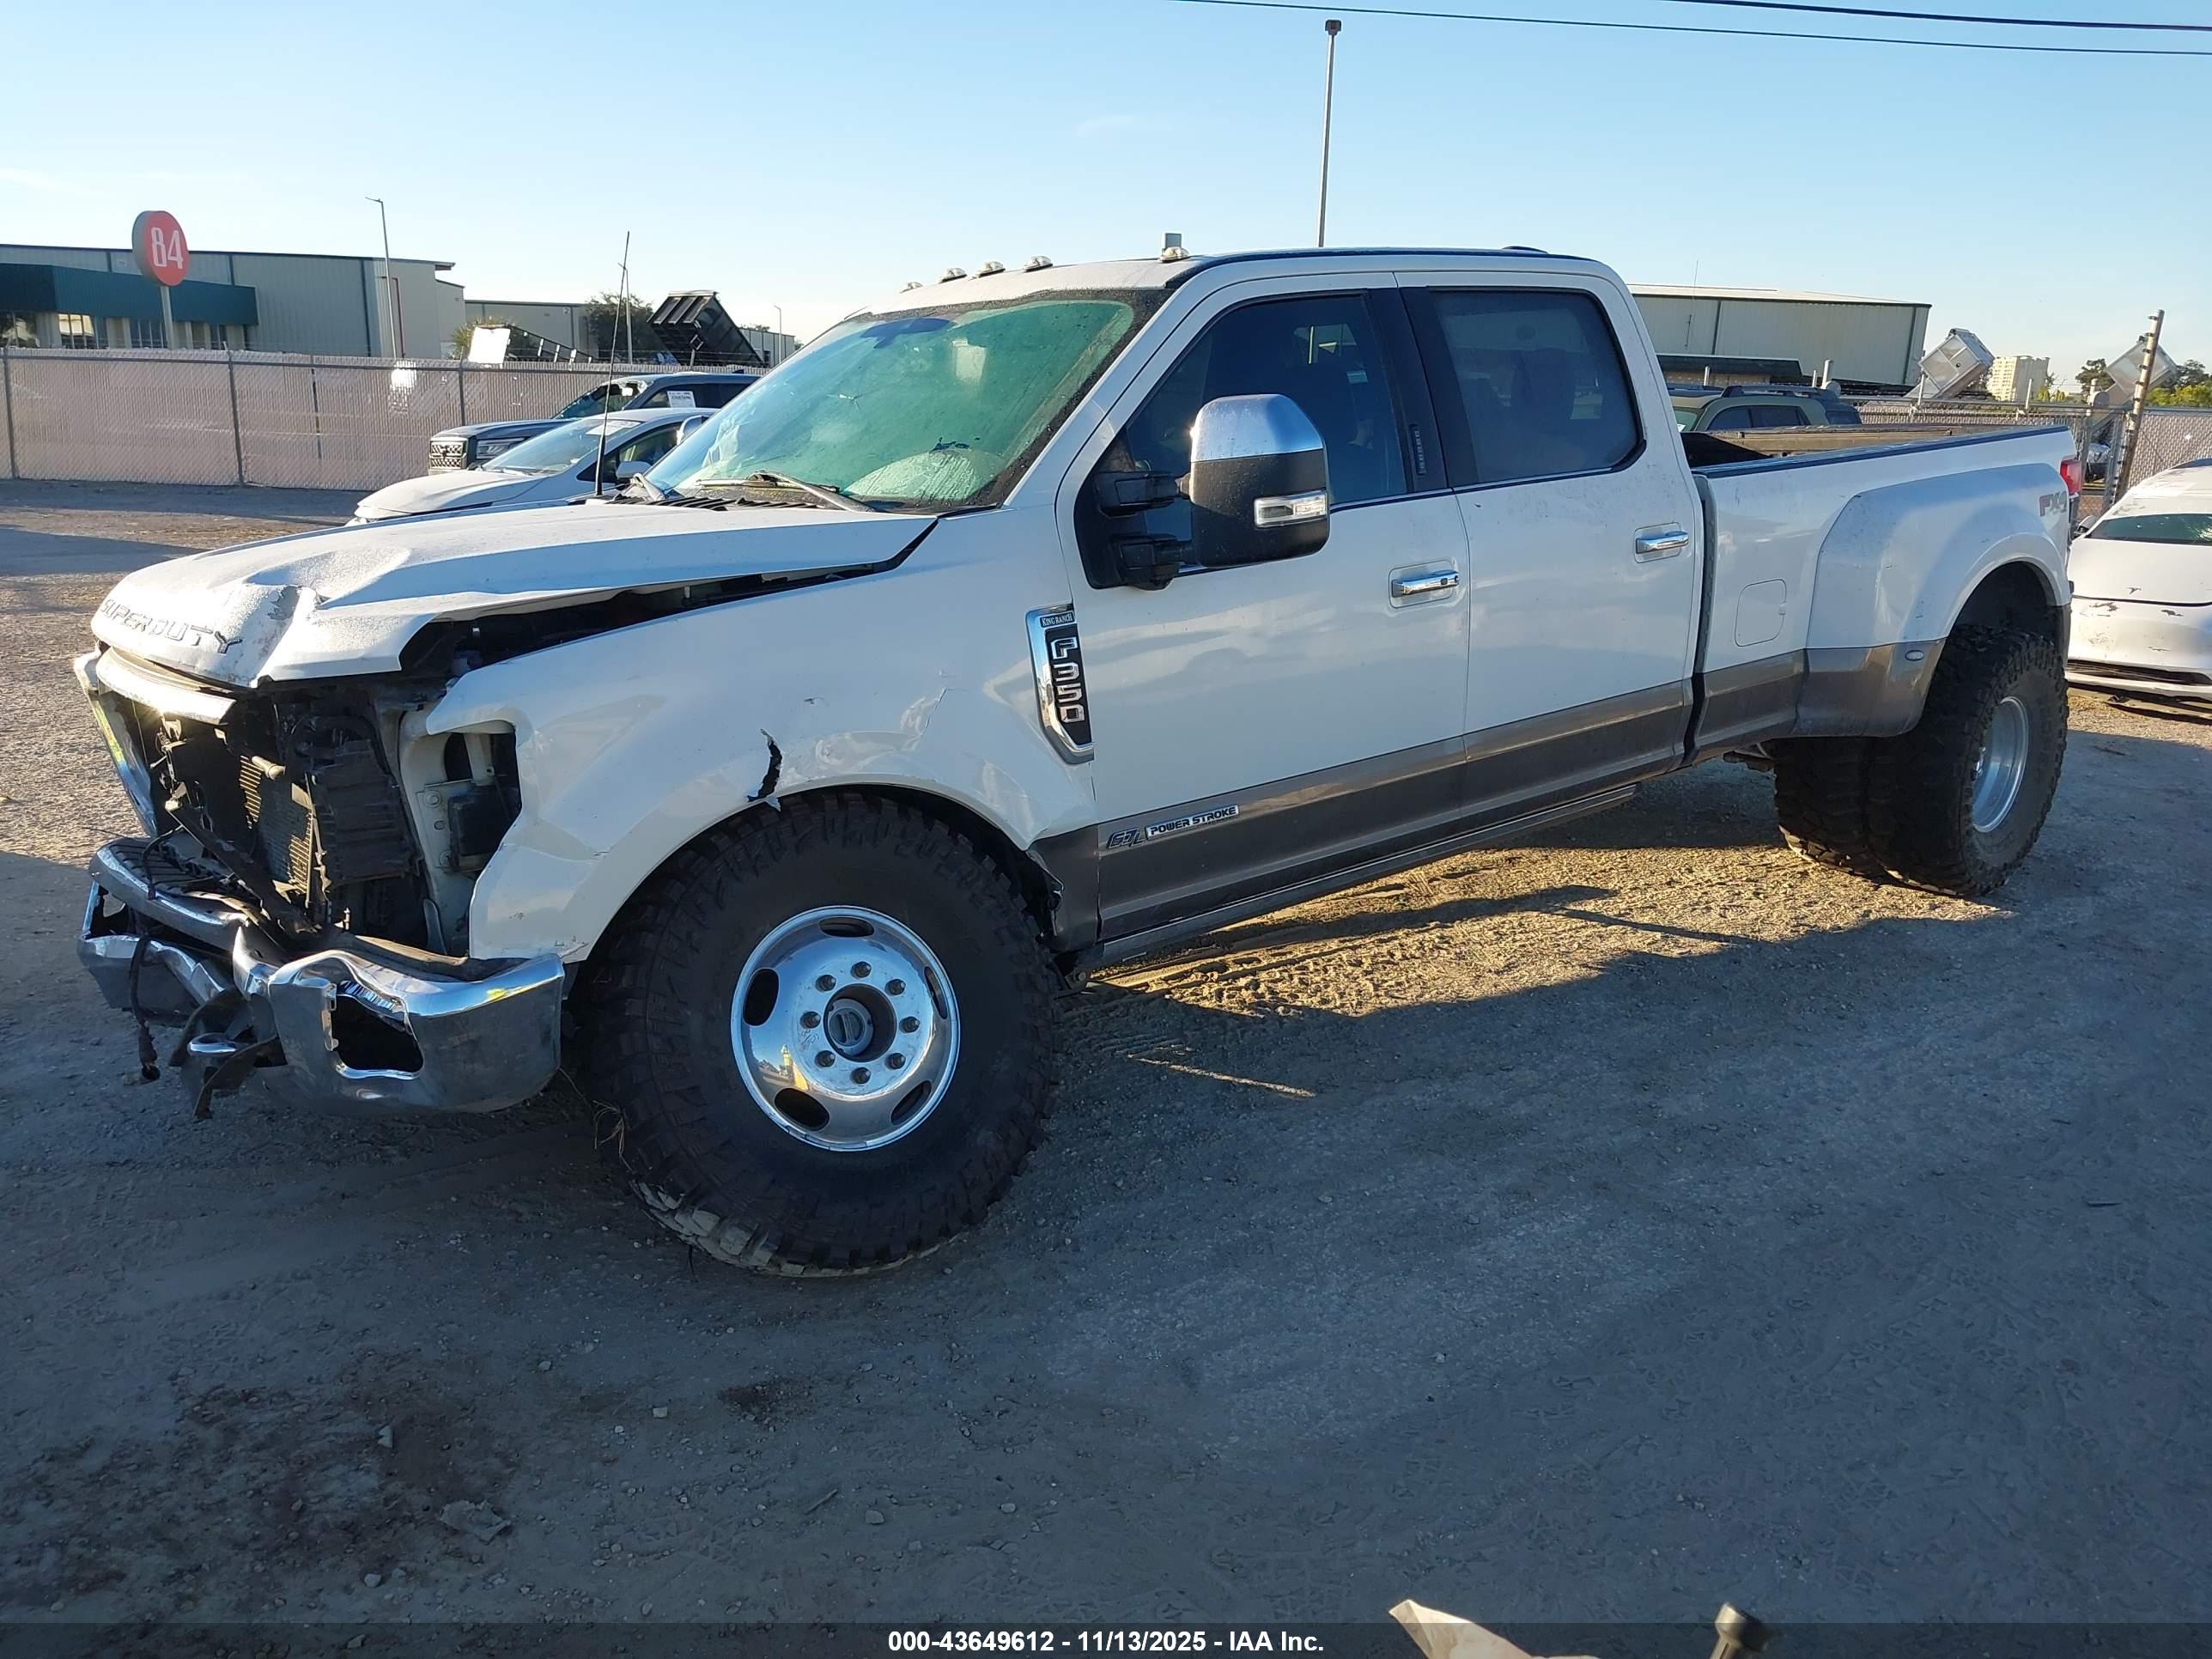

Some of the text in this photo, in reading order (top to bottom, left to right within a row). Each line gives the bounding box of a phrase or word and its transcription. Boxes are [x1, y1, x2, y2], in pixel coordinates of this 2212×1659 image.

[150, 227, 184, 270] 84
[1042, 613, 1073, 627] KING RANCH
[1051, 636, 1085, 723] F350
[1150, 818, 1191, 836] POWER
[1192, 806, 1237, 824] STROKE
